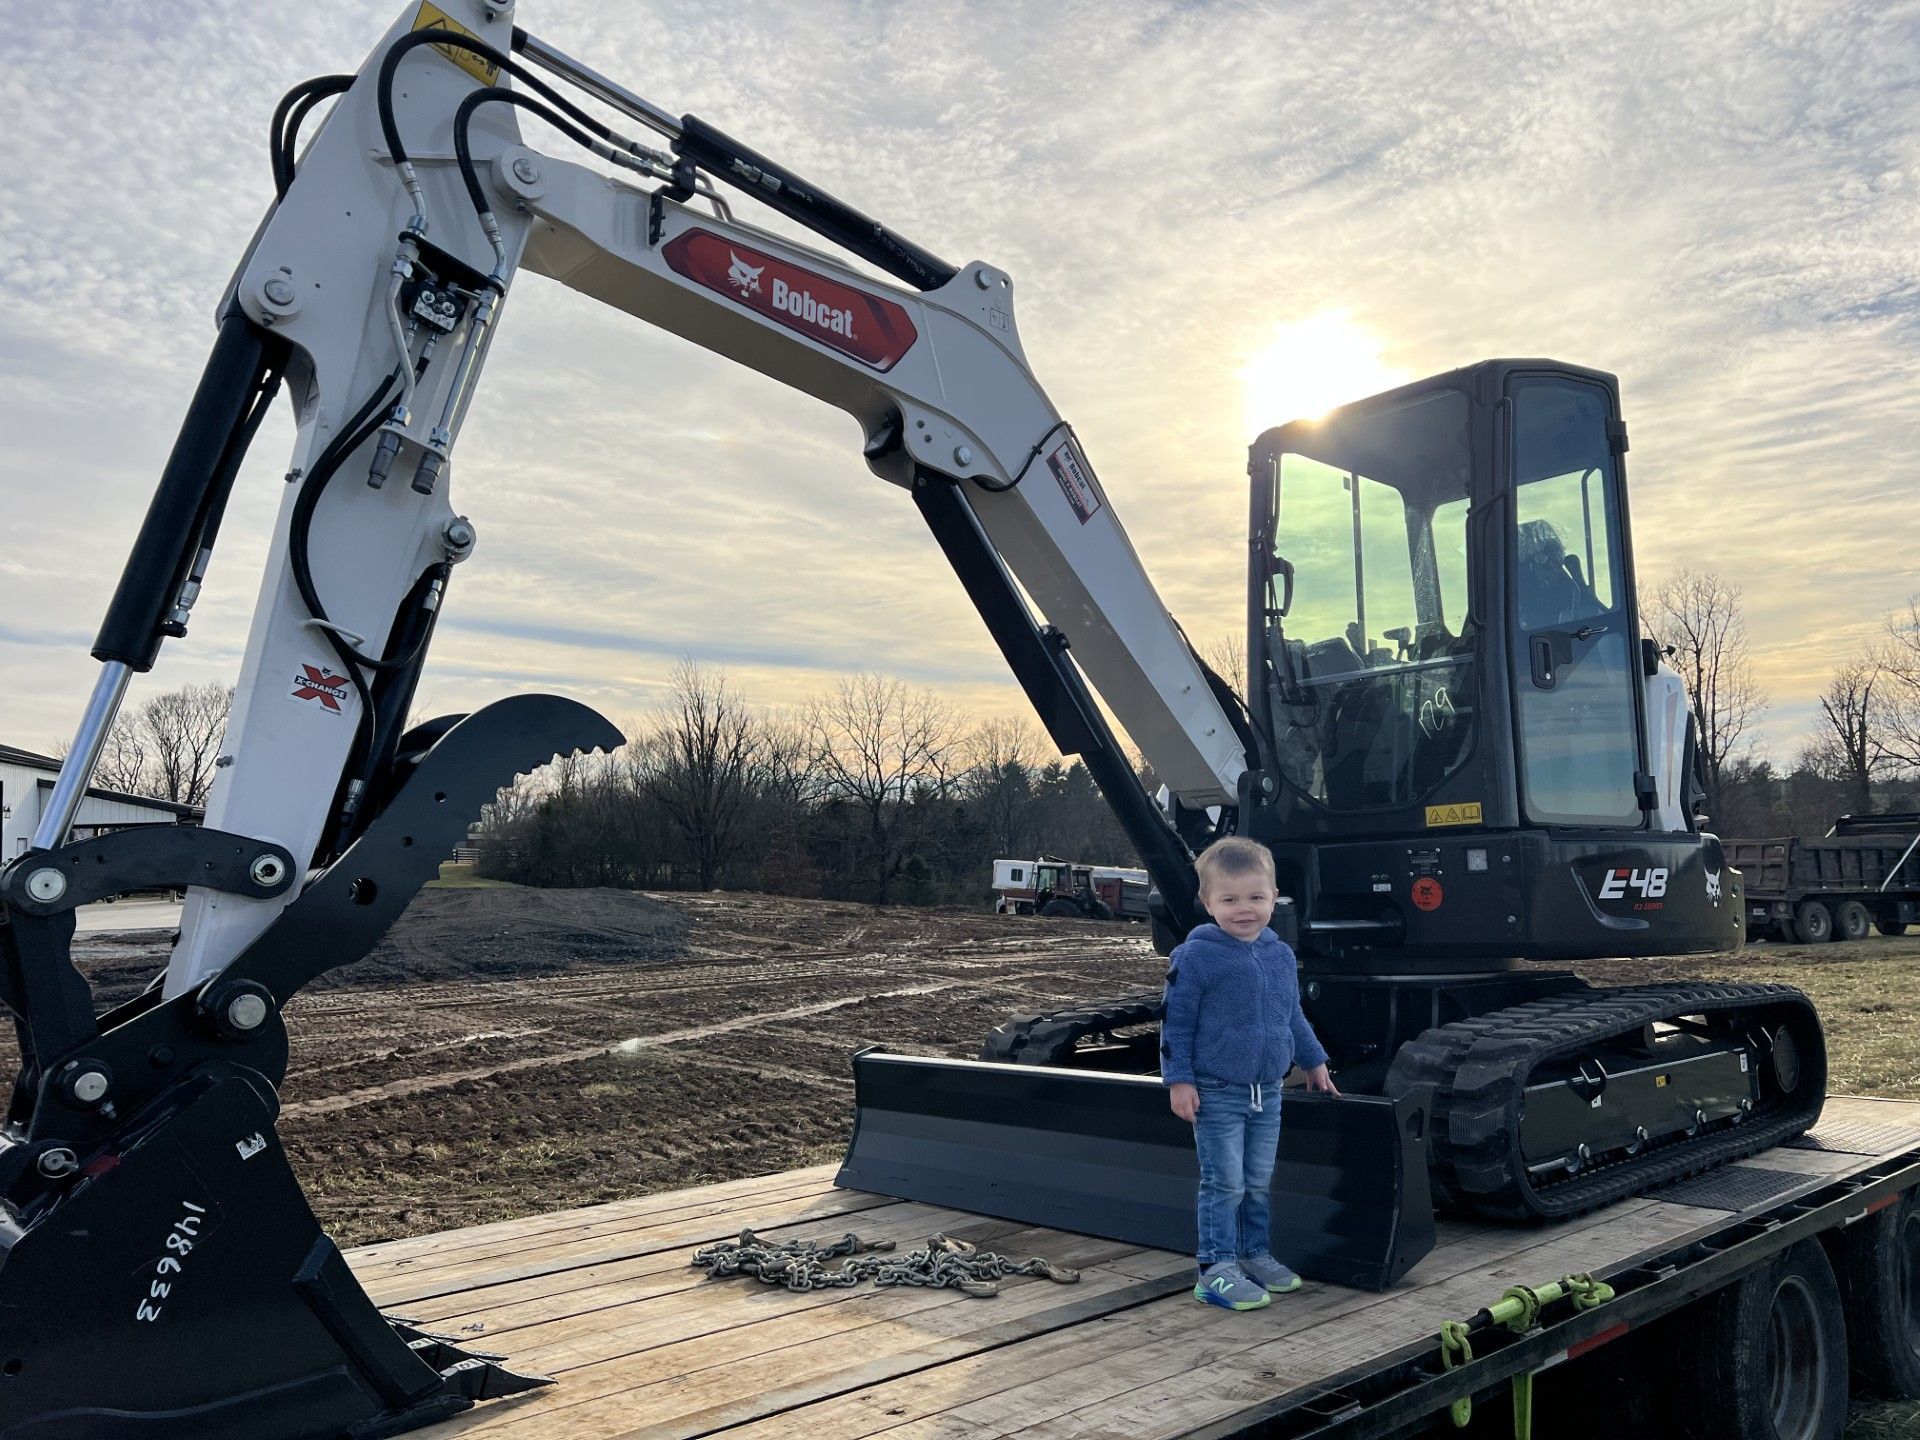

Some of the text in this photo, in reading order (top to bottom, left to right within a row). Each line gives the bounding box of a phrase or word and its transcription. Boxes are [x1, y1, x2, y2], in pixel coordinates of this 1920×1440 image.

[772, 278, 855, 340] Bobcat
[1069, 463, 1086, 490] Bobcat
[296, 676, 346, 699] X-CHANGE
[1598, 867, 1669, 899] E48
[136, 1200, 206, 1322] 148633
